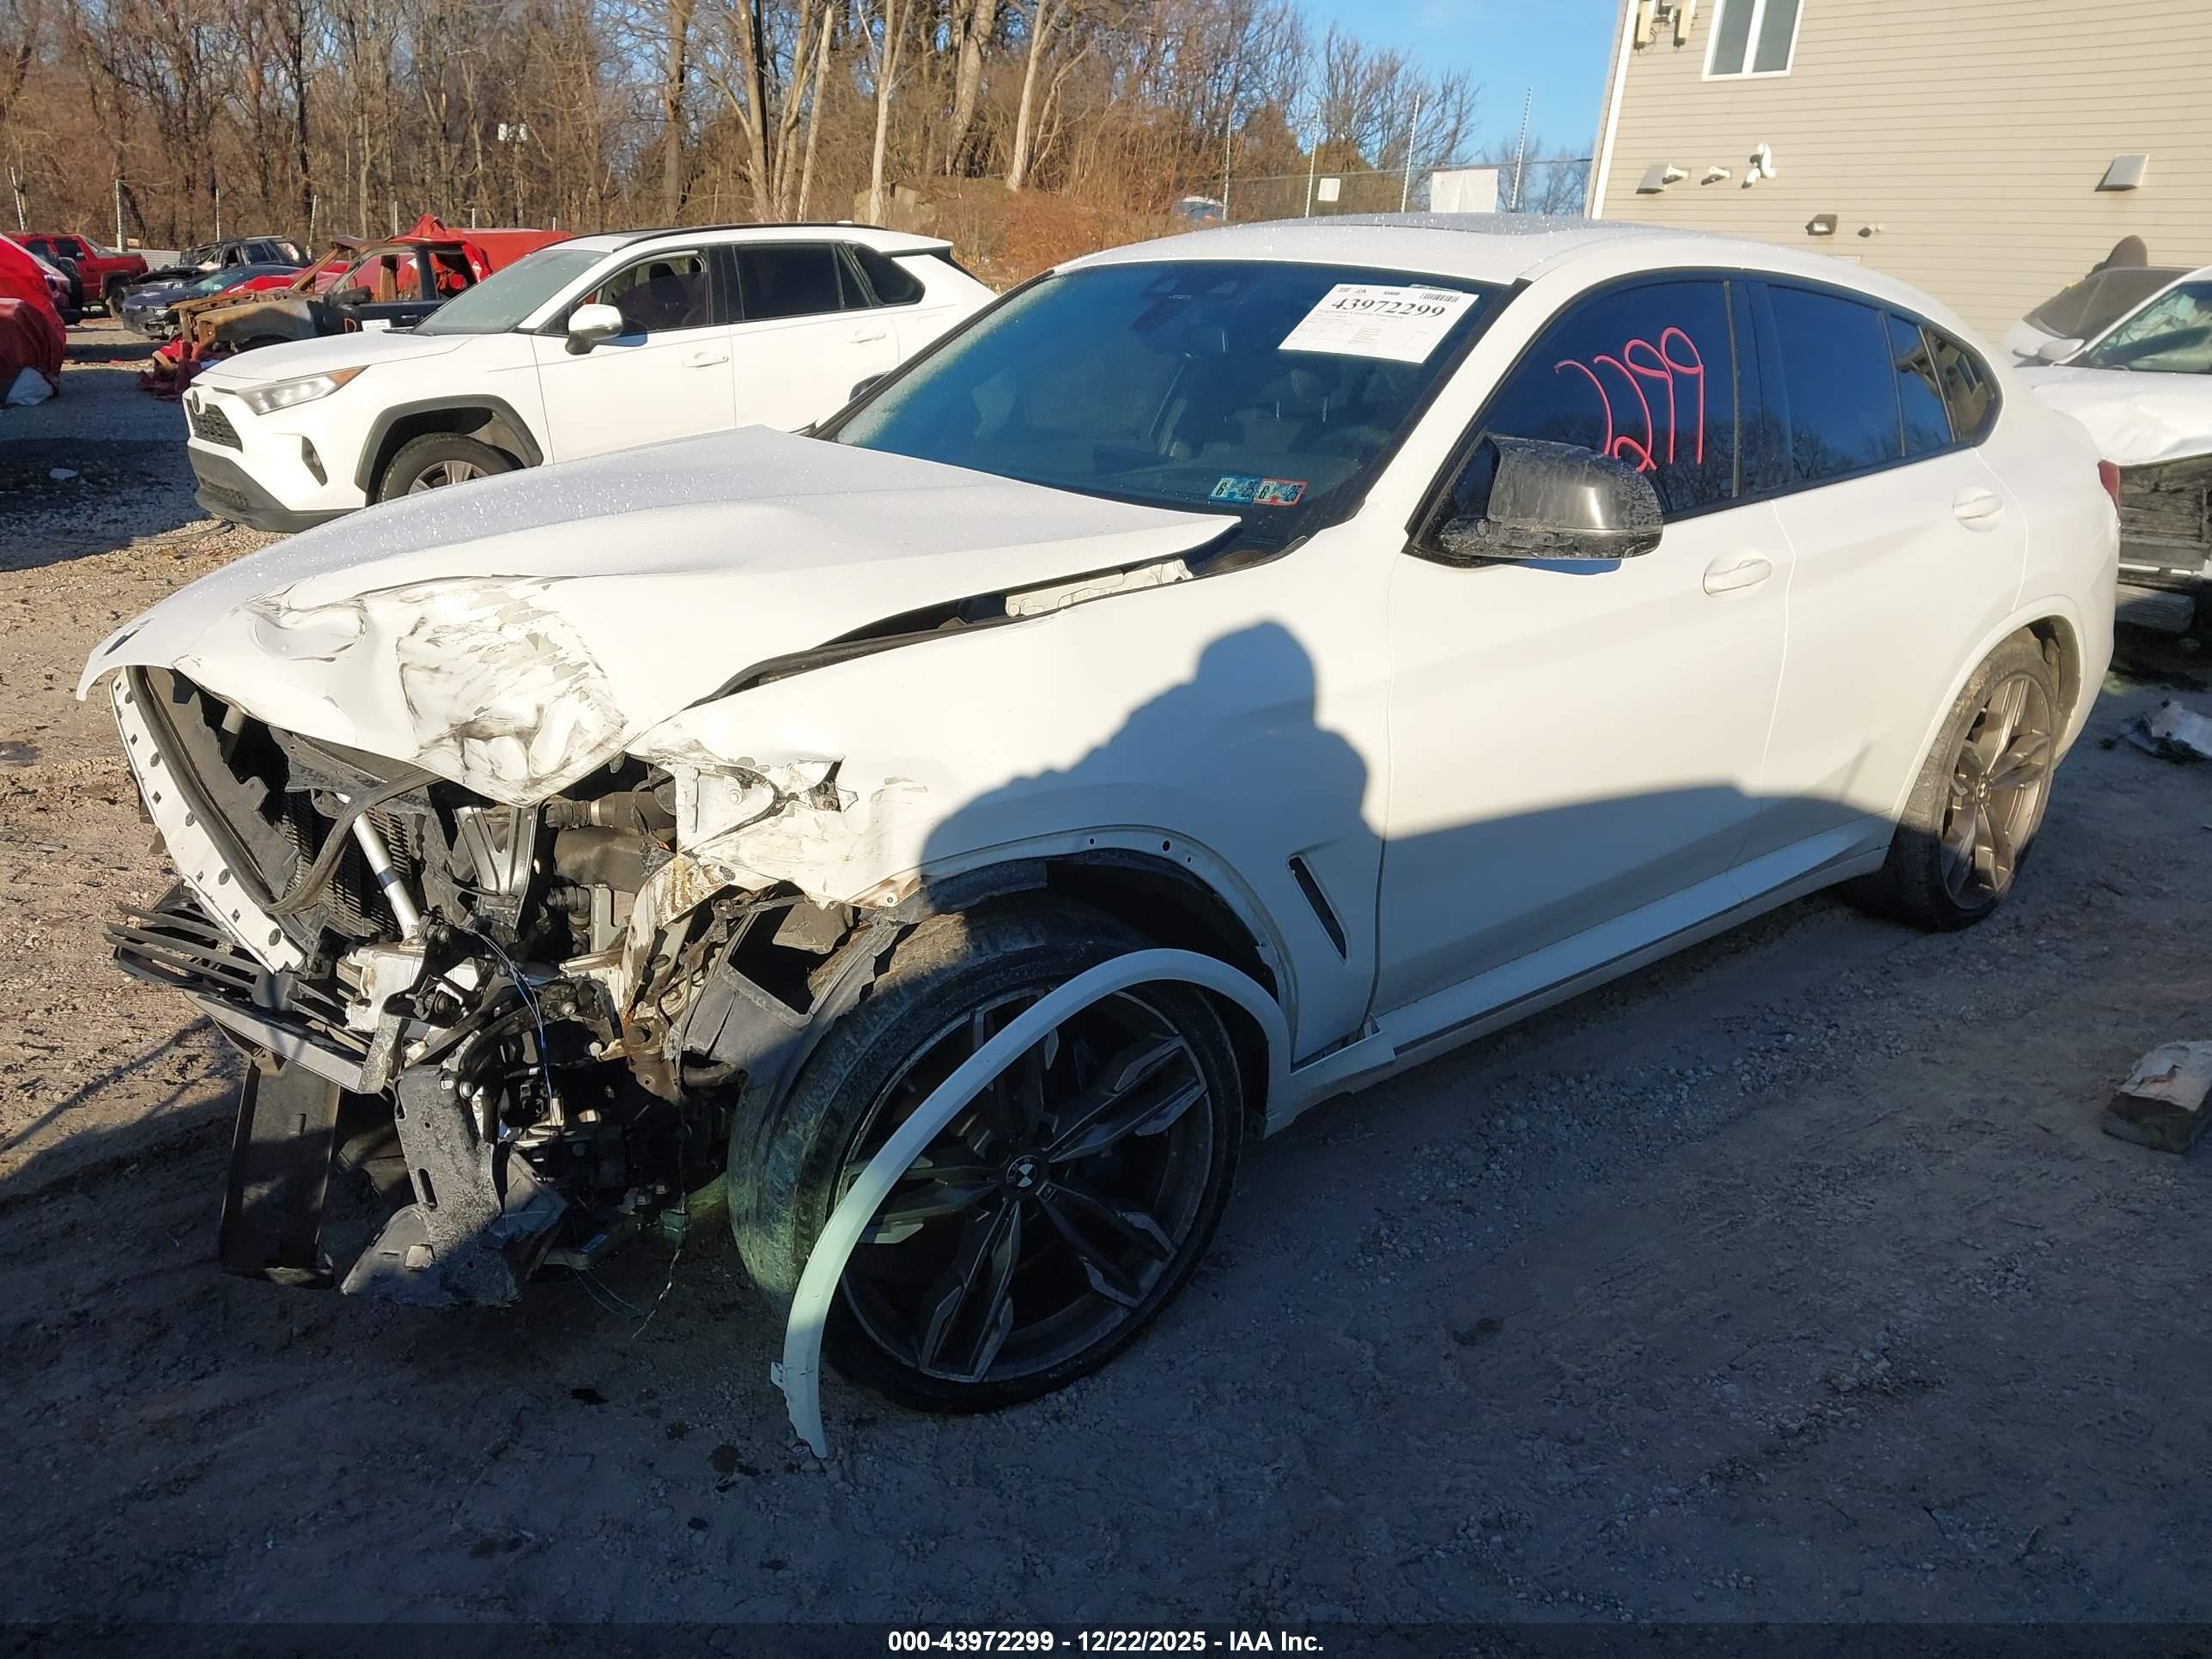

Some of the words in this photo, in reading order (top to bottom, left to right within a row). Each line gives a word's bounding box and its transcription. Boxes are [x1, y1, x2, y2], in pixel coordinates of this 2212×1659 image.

[1331, 297, 1446, 318] 43972299
[1216, 482, 1226, 496] 6
[1259, 484, 1269, 500] 6
